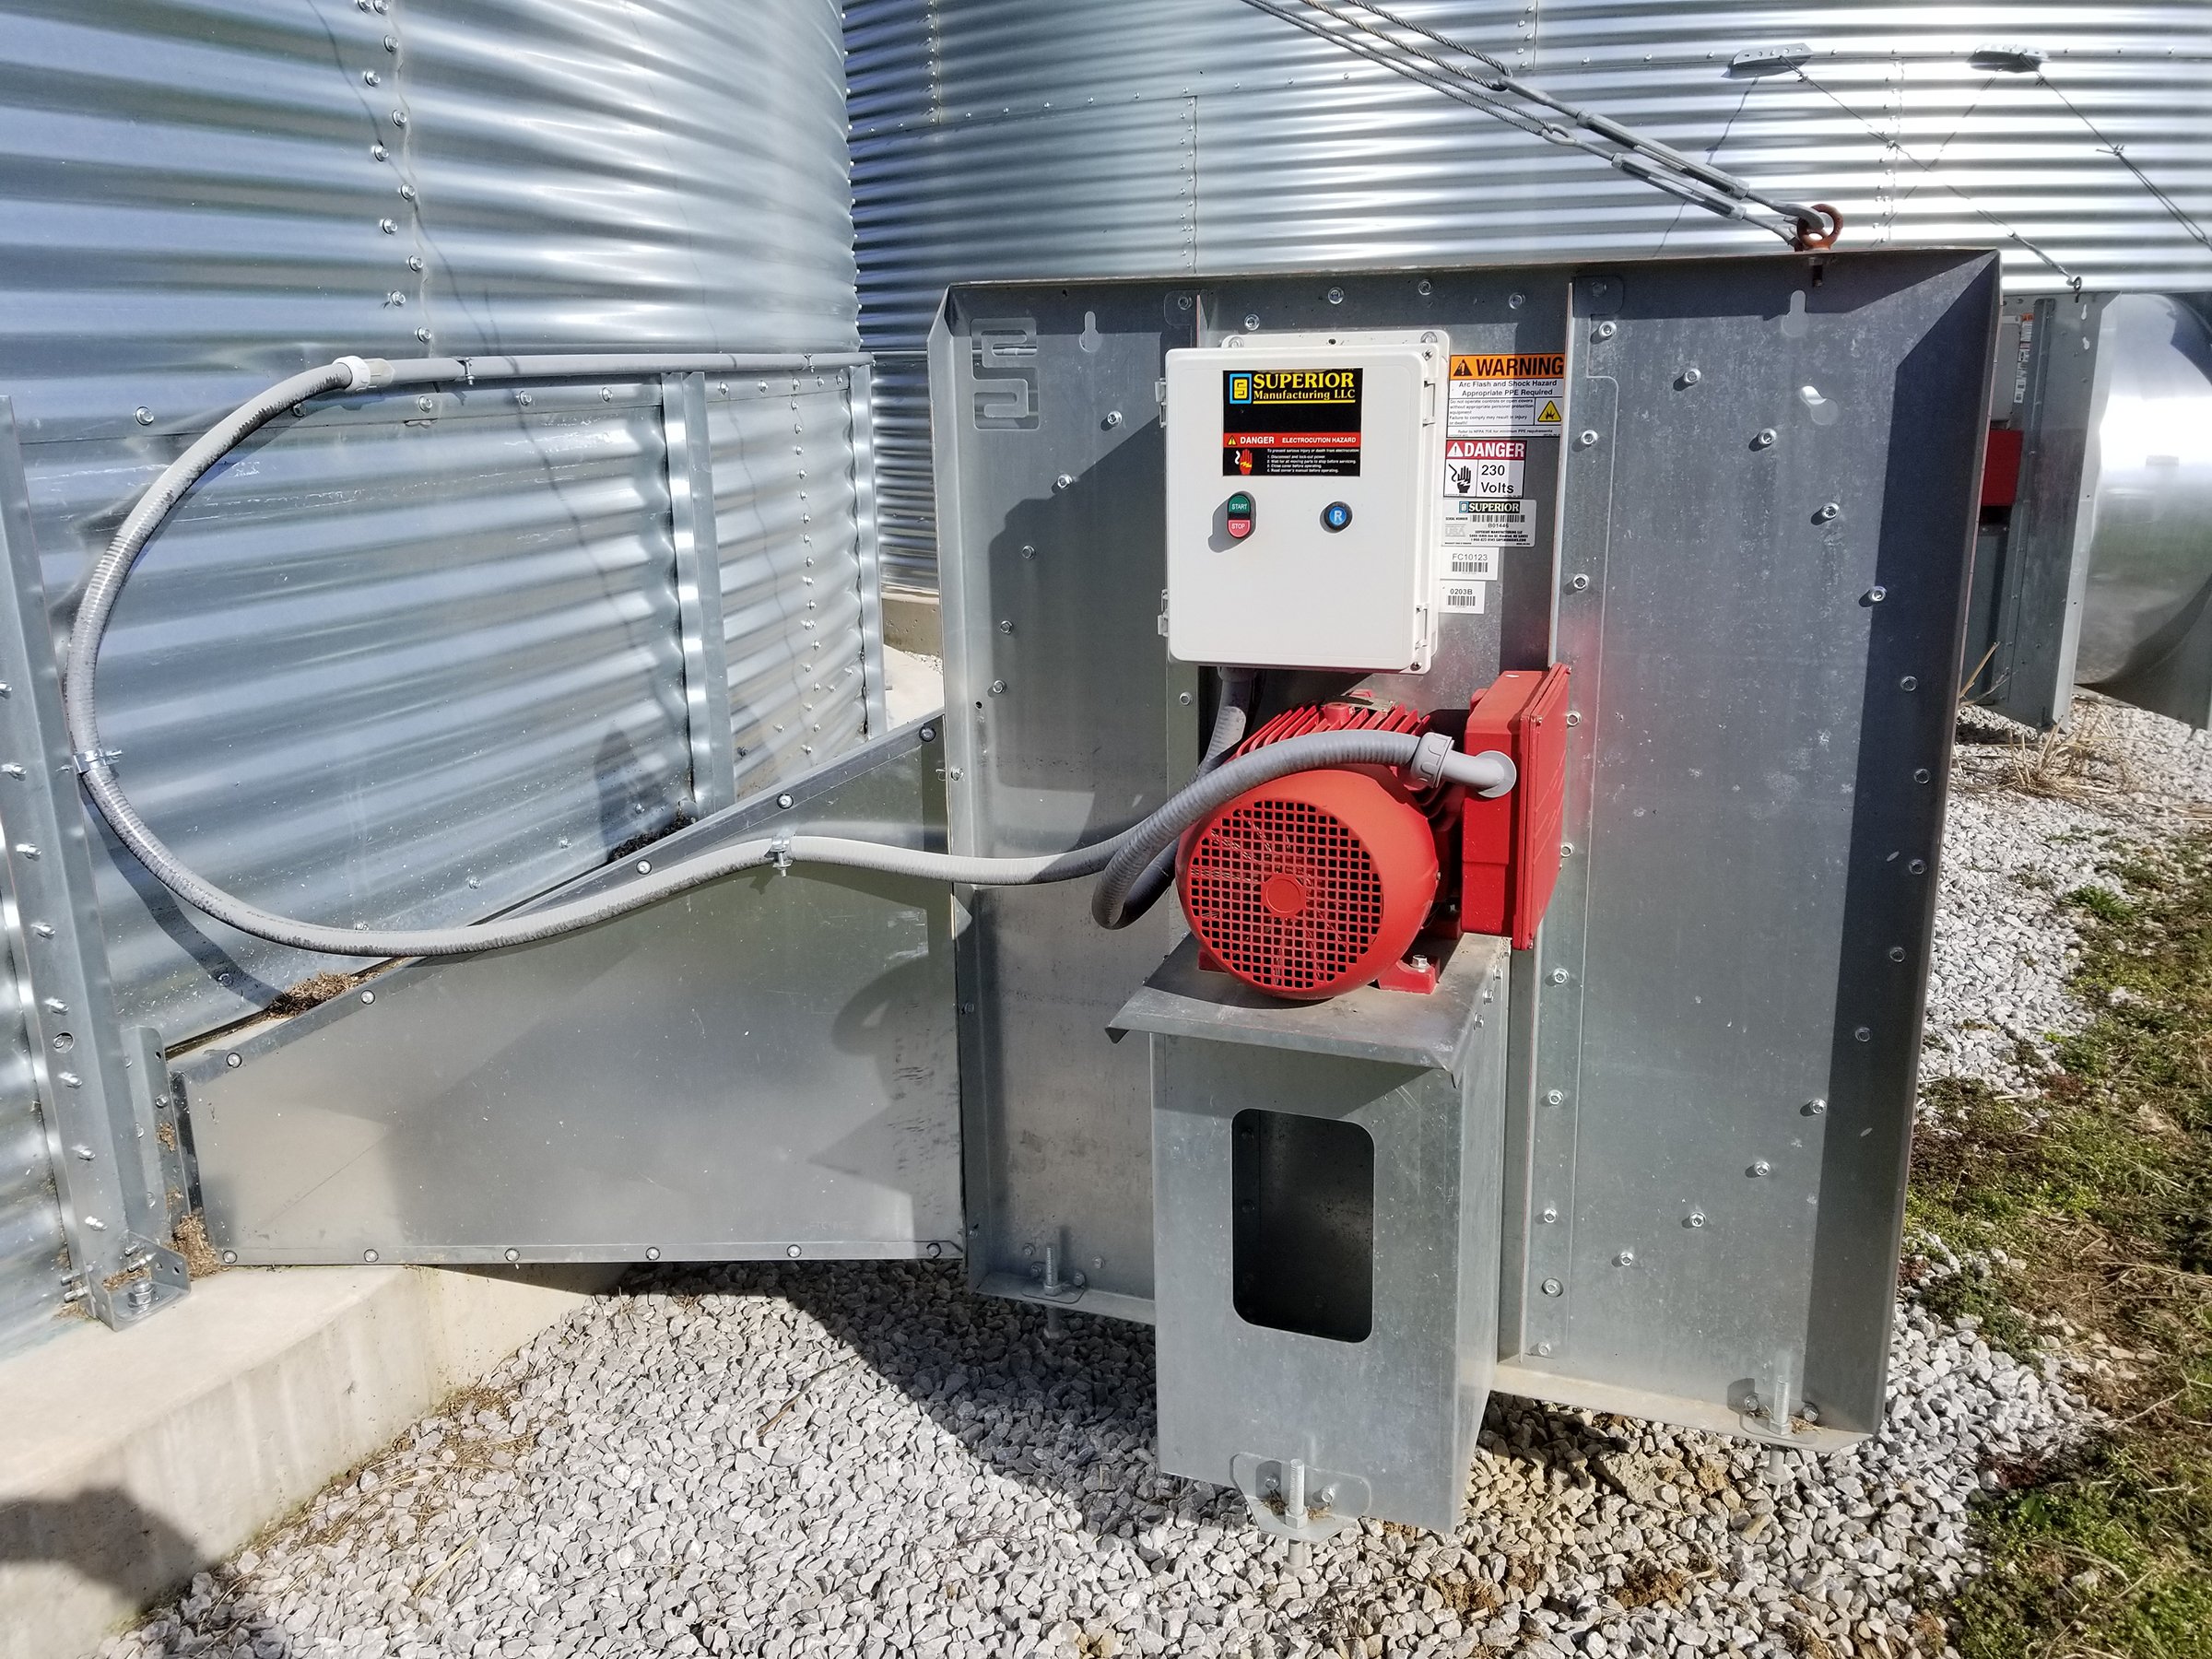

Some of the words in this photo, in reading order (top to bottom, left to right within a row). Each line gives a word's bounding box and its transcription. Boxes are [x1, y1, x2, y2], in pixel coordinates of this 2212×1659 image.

[1476, 357, 1564, 377] WARNING
[1253, 372, 1355, 389] SUPERIOR
[1253, 390, 1330, 401] Manufacturing
[1334, 389, 1356, 399] LLC
[1462, 389, 1503, 397] Appropriate
[1520, 388, 1553, 396] Required
[1240, 436, 1275, 444] DANGER
[1464, 442, 1524, 457] DANGER
[1481, 465, 1505, 476] 230
[1481, 482, 1514, 493] Volts
[1468, 502, 1520, 512] SUPERIOR
[1335, 510, 1343, 523] R
